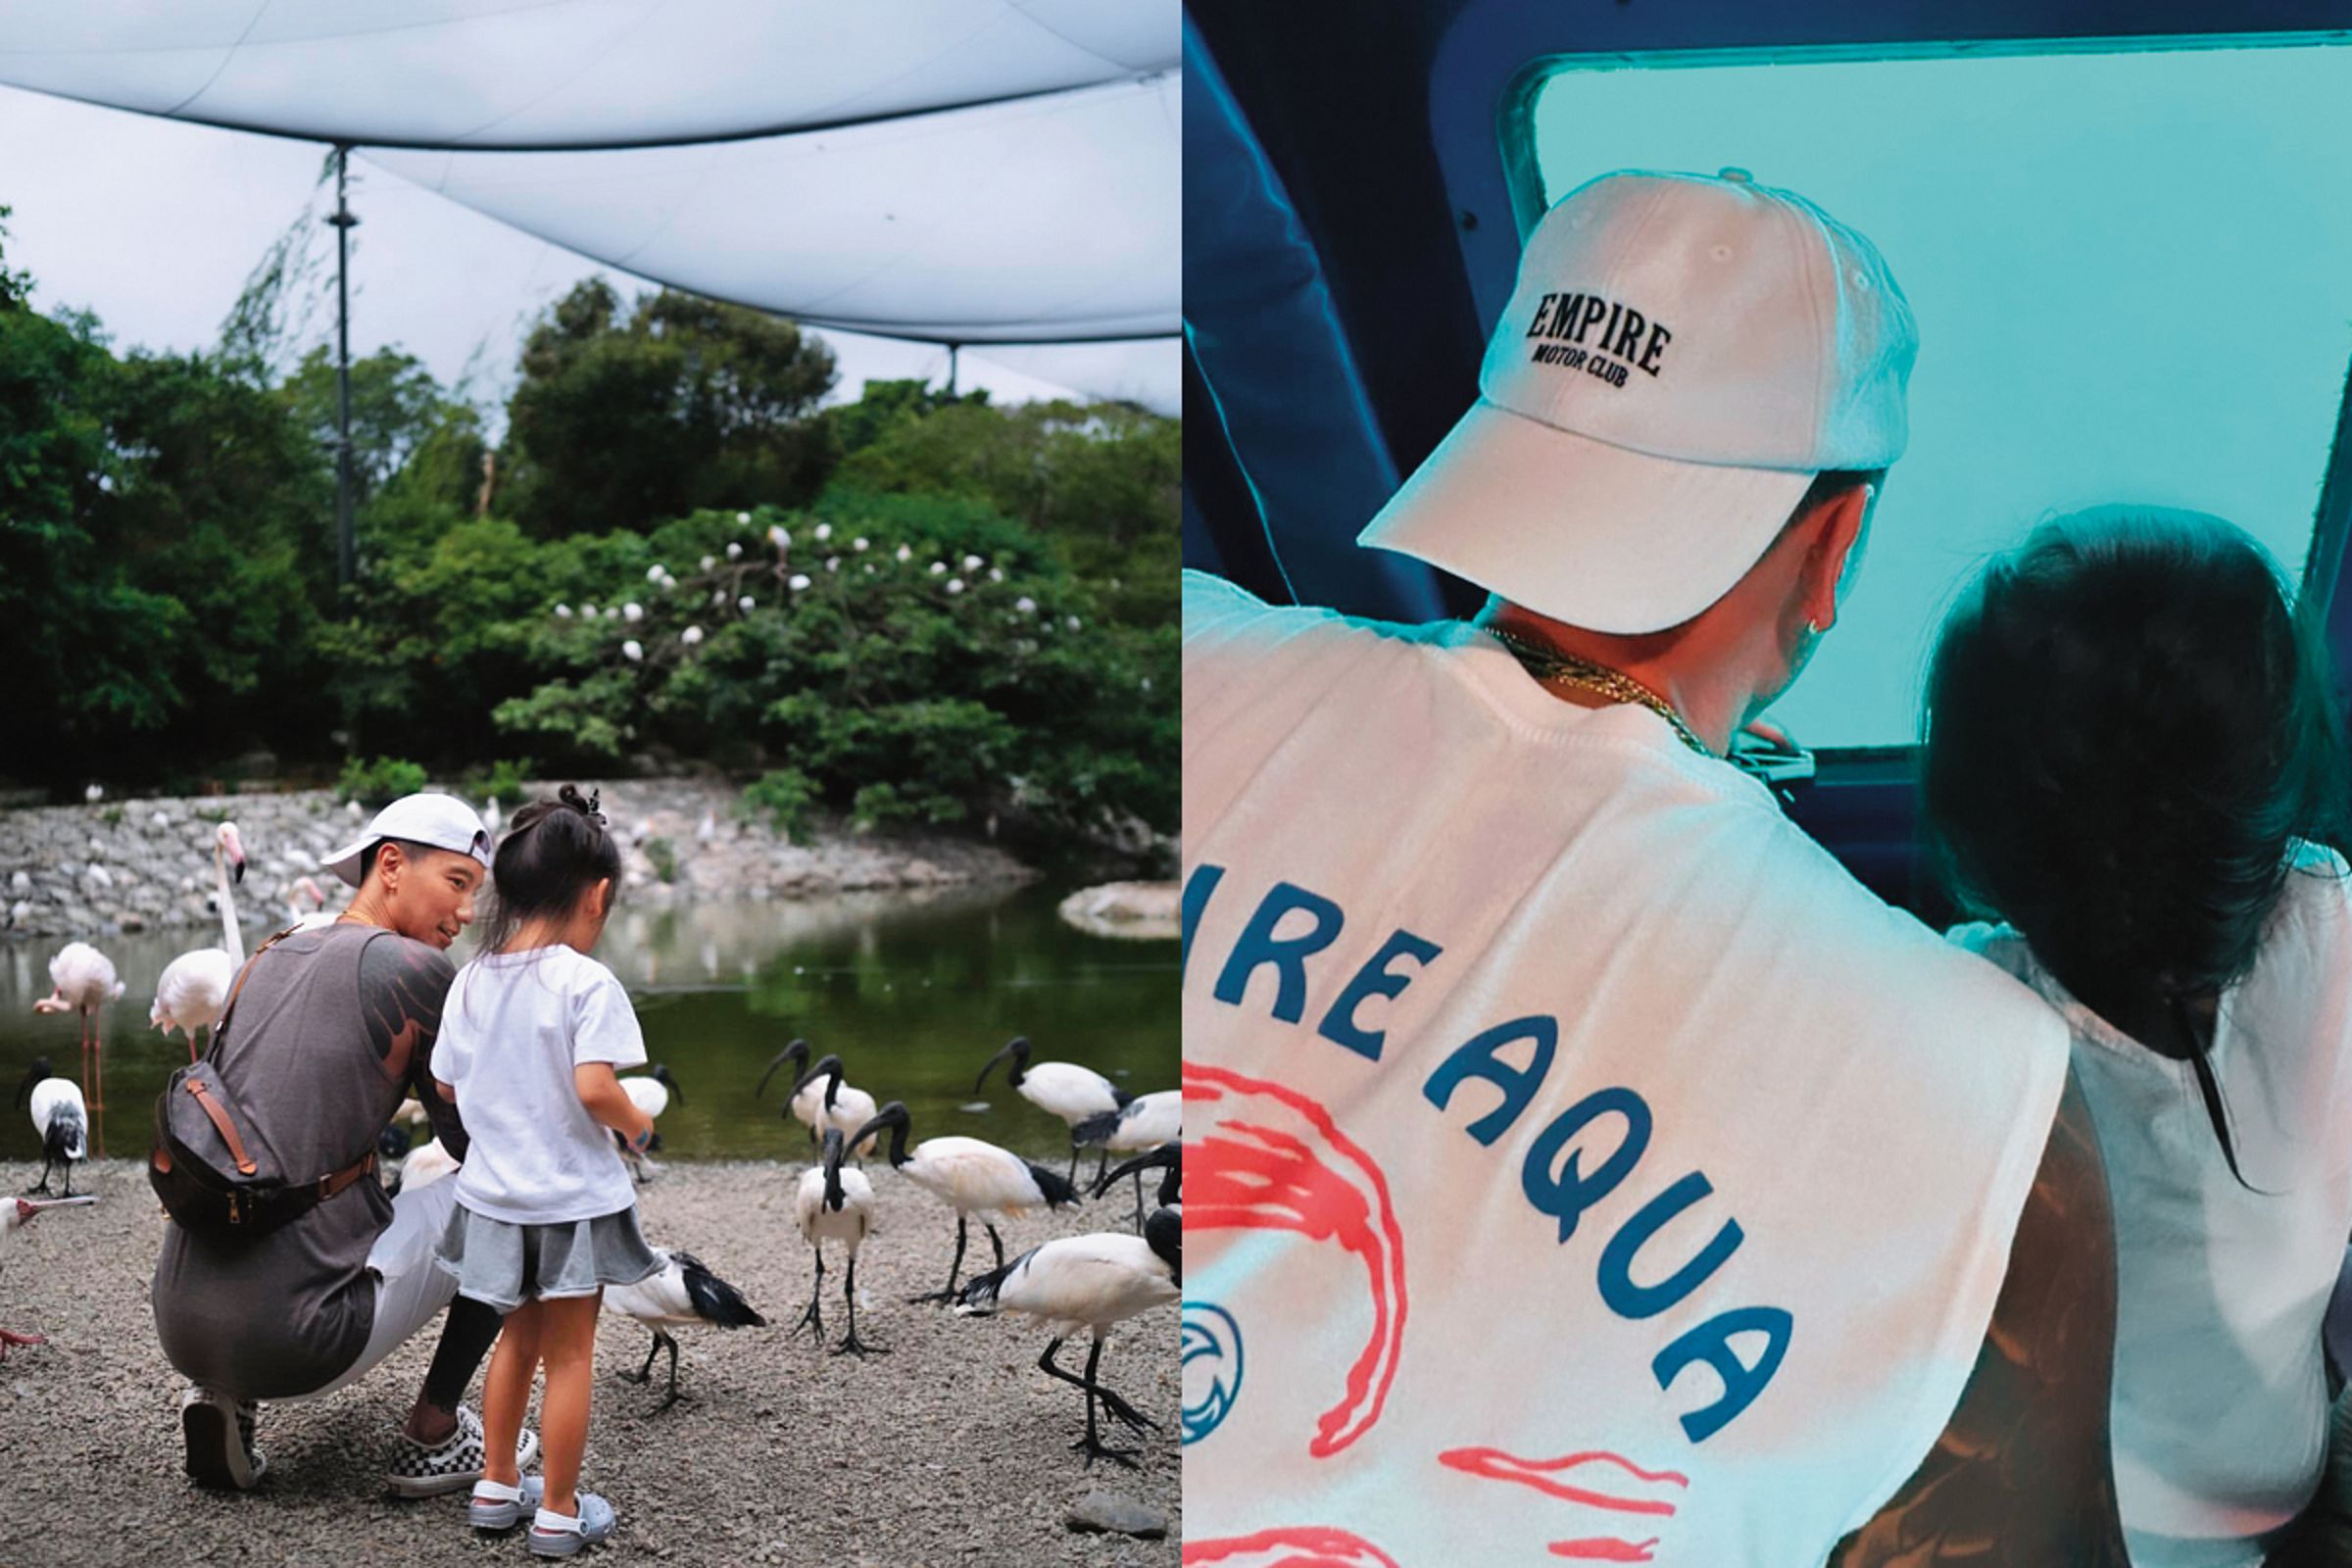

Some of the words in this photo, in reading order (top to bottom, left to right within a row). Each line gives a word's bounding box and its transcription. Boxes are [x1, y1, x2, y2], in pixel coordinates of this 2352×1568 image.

[1526, 293, 1672, 377] EMPIRE
[1531, 344, 1589, 371] MOTOR
[1586, 355, 1630, 388] CLUB
[1423, 1014, 1794, 1445] AQUA
